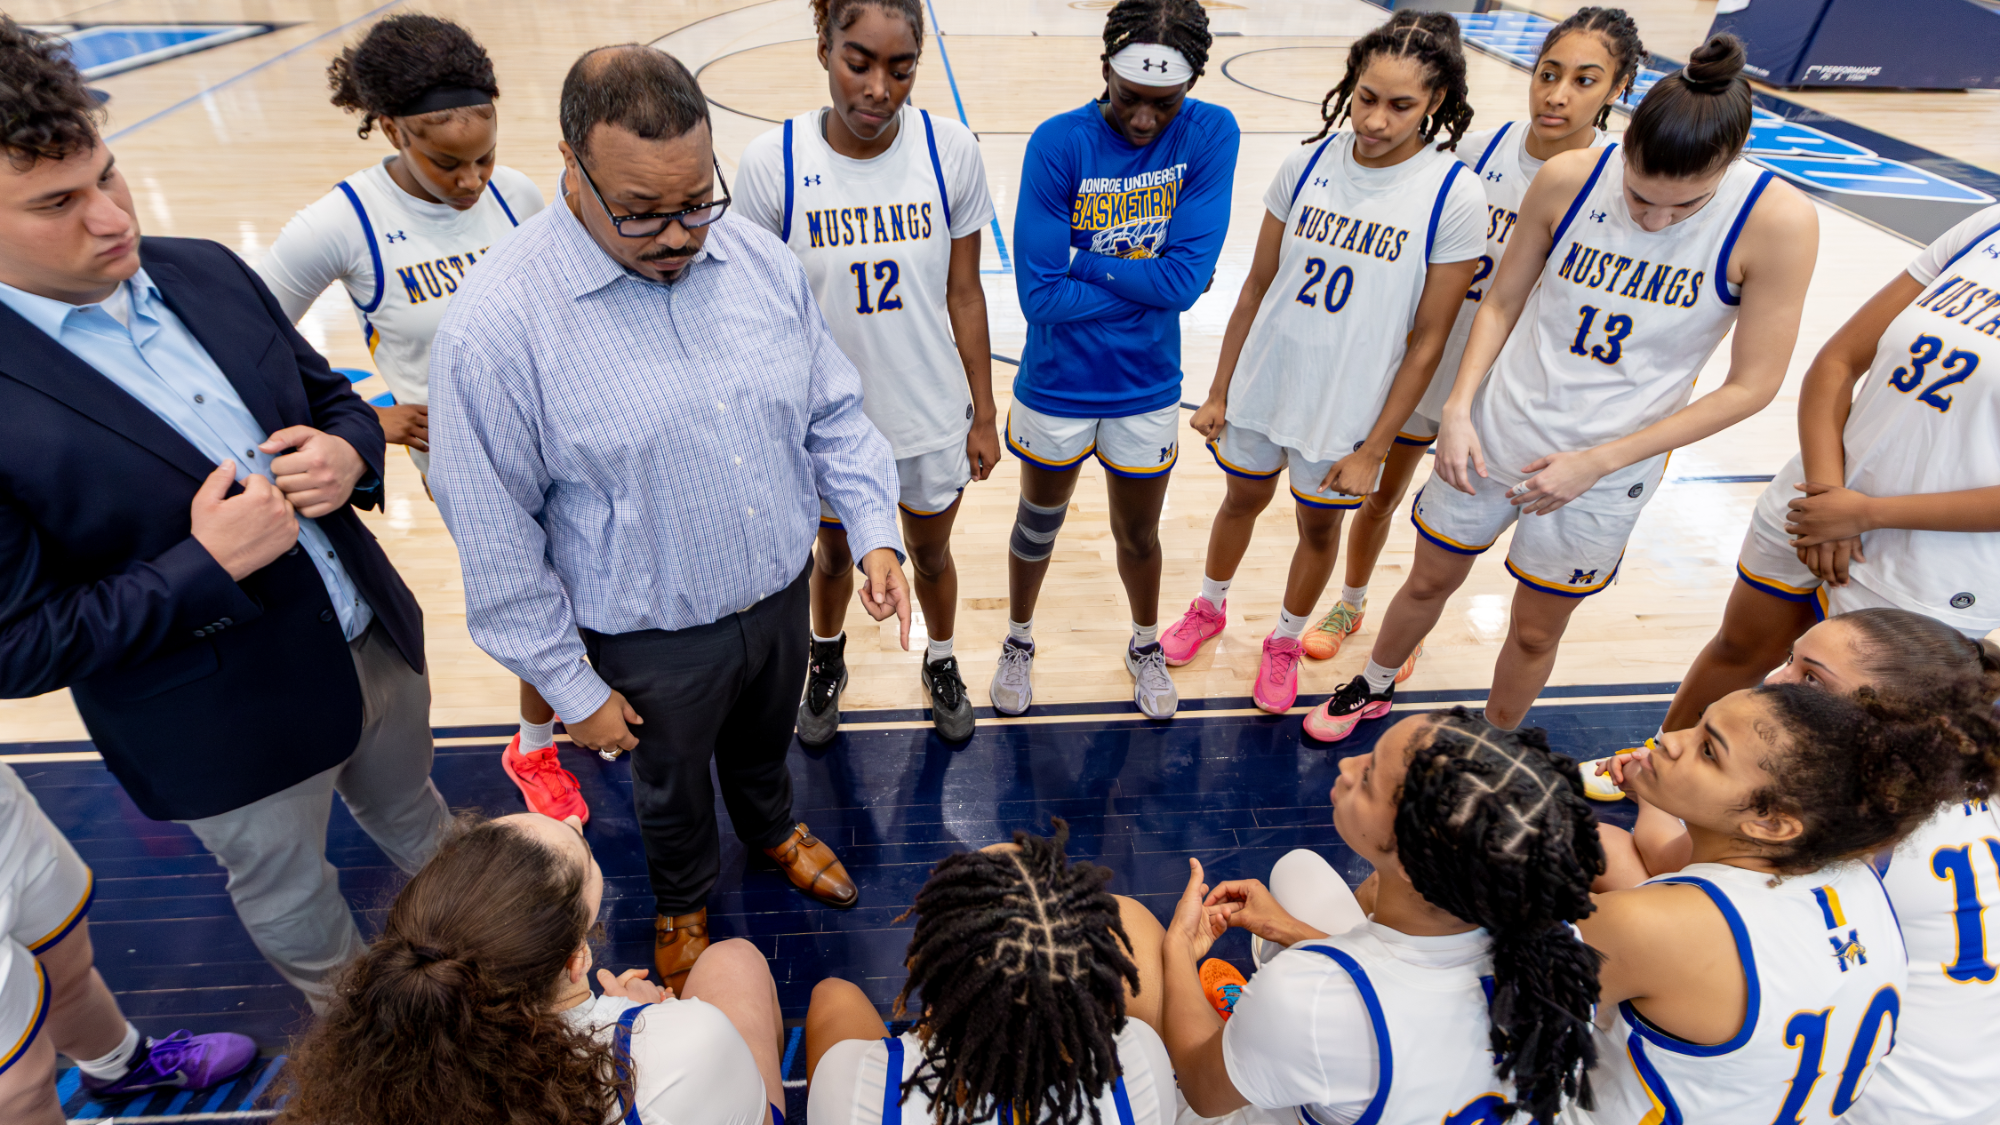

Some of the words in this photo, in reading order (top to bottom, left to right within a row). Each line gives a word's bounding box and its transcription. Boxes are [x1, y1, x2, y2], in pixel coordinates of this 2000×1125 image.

[1820, 65, 1882, 76] PERFORMANCE
[1071, 179, 1183, 231] BASKETBA
[1124, 162, 1187, 193] UNIVERST
[805, 202, 932, 249] MUSTANGS
[1294, 204, 1410, 263] MUSTANGS
[849, 258, 904, 315] 12
[1295, 256, 1354, 315] 20
[1558, 241, 1705, 308] MUSTANGS
[1569, 304, 1634, 366] 13
[1887, 332, 1981, 413] 32
[1768, 982, 1901, 1125] 10
